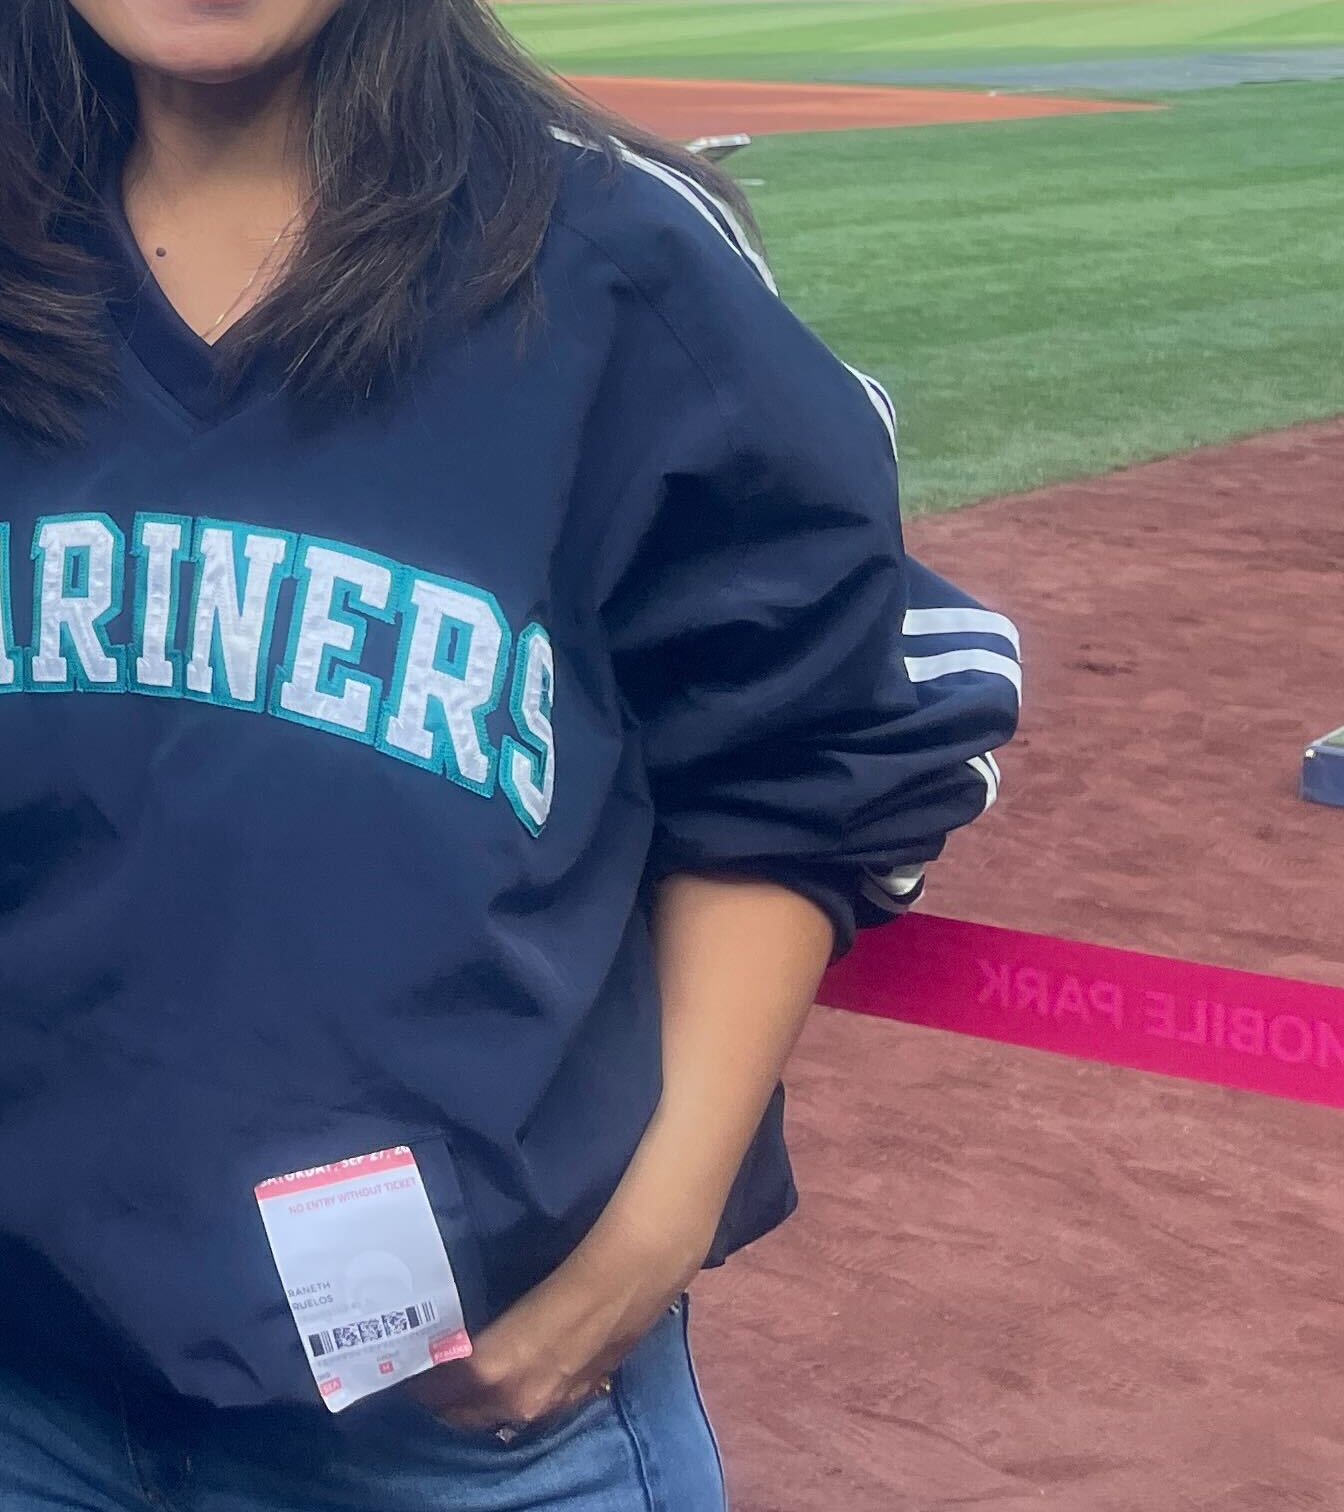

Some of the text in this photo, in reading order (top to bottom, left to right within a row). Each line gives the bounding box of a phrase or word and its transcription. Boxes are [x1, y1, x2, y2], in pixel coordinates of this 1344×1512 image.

[288, 1176, 418, 1215] NO ENTRY WITHOUT TICKET
[287, 1280, 332, 1299] RANETH
[291, 1294, 334, 1311] RUELOS
